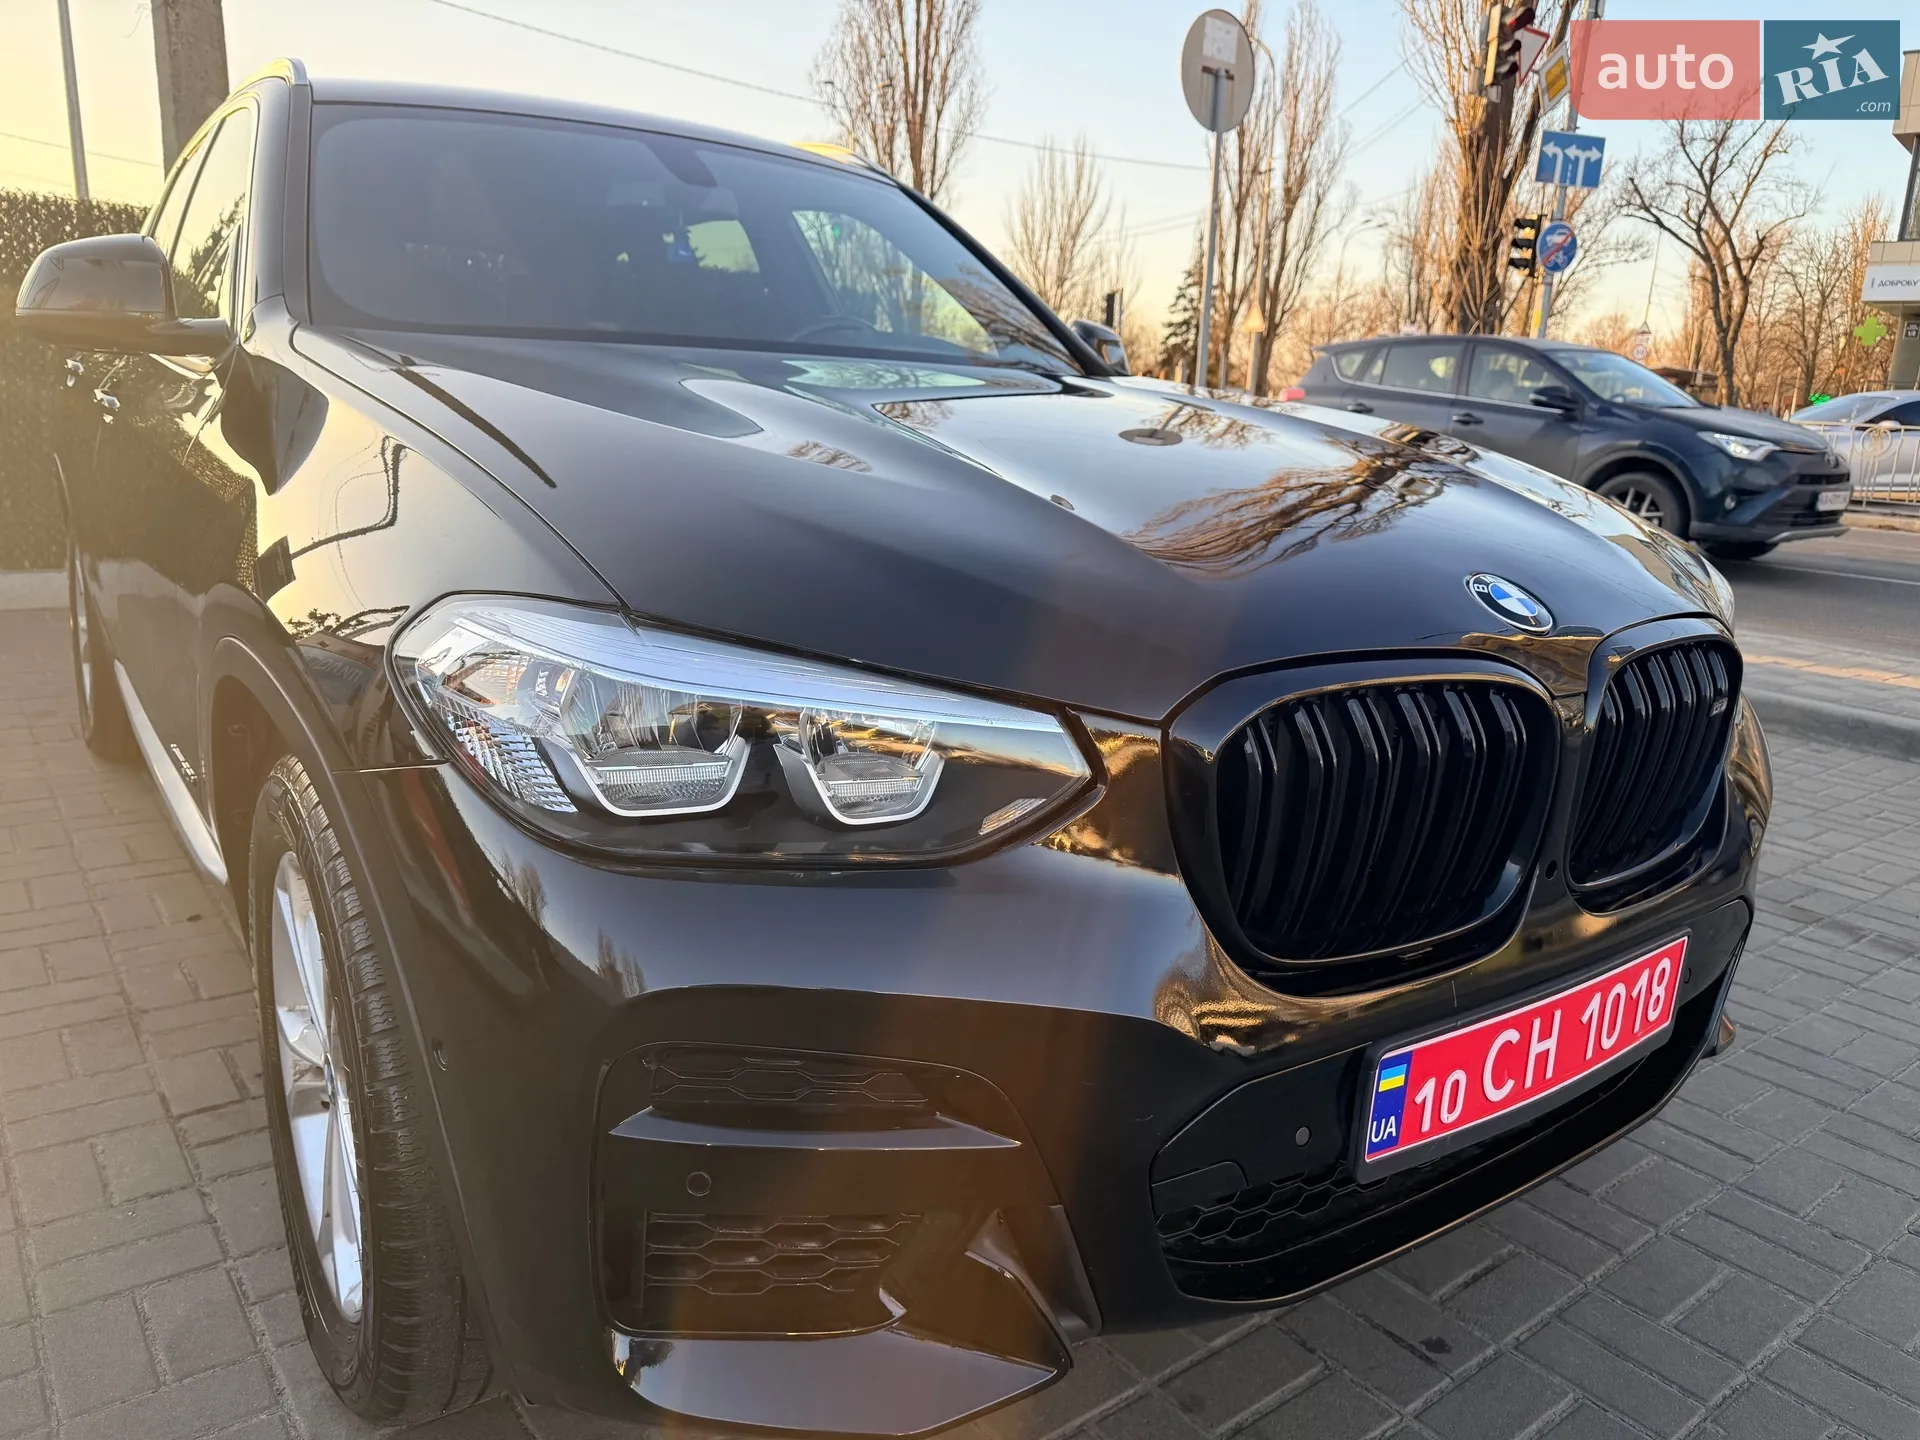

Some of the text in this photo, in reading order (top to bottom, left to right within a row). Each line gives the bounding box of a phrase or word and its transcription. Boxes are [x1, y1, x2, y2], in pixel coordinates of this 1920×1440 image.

[1878, 279, 1920, 288] ДОБРОБУ
[1414, 956, 1671, 1132] 10 CH 1018
[1371, 1116, 1397, 1143] UA
